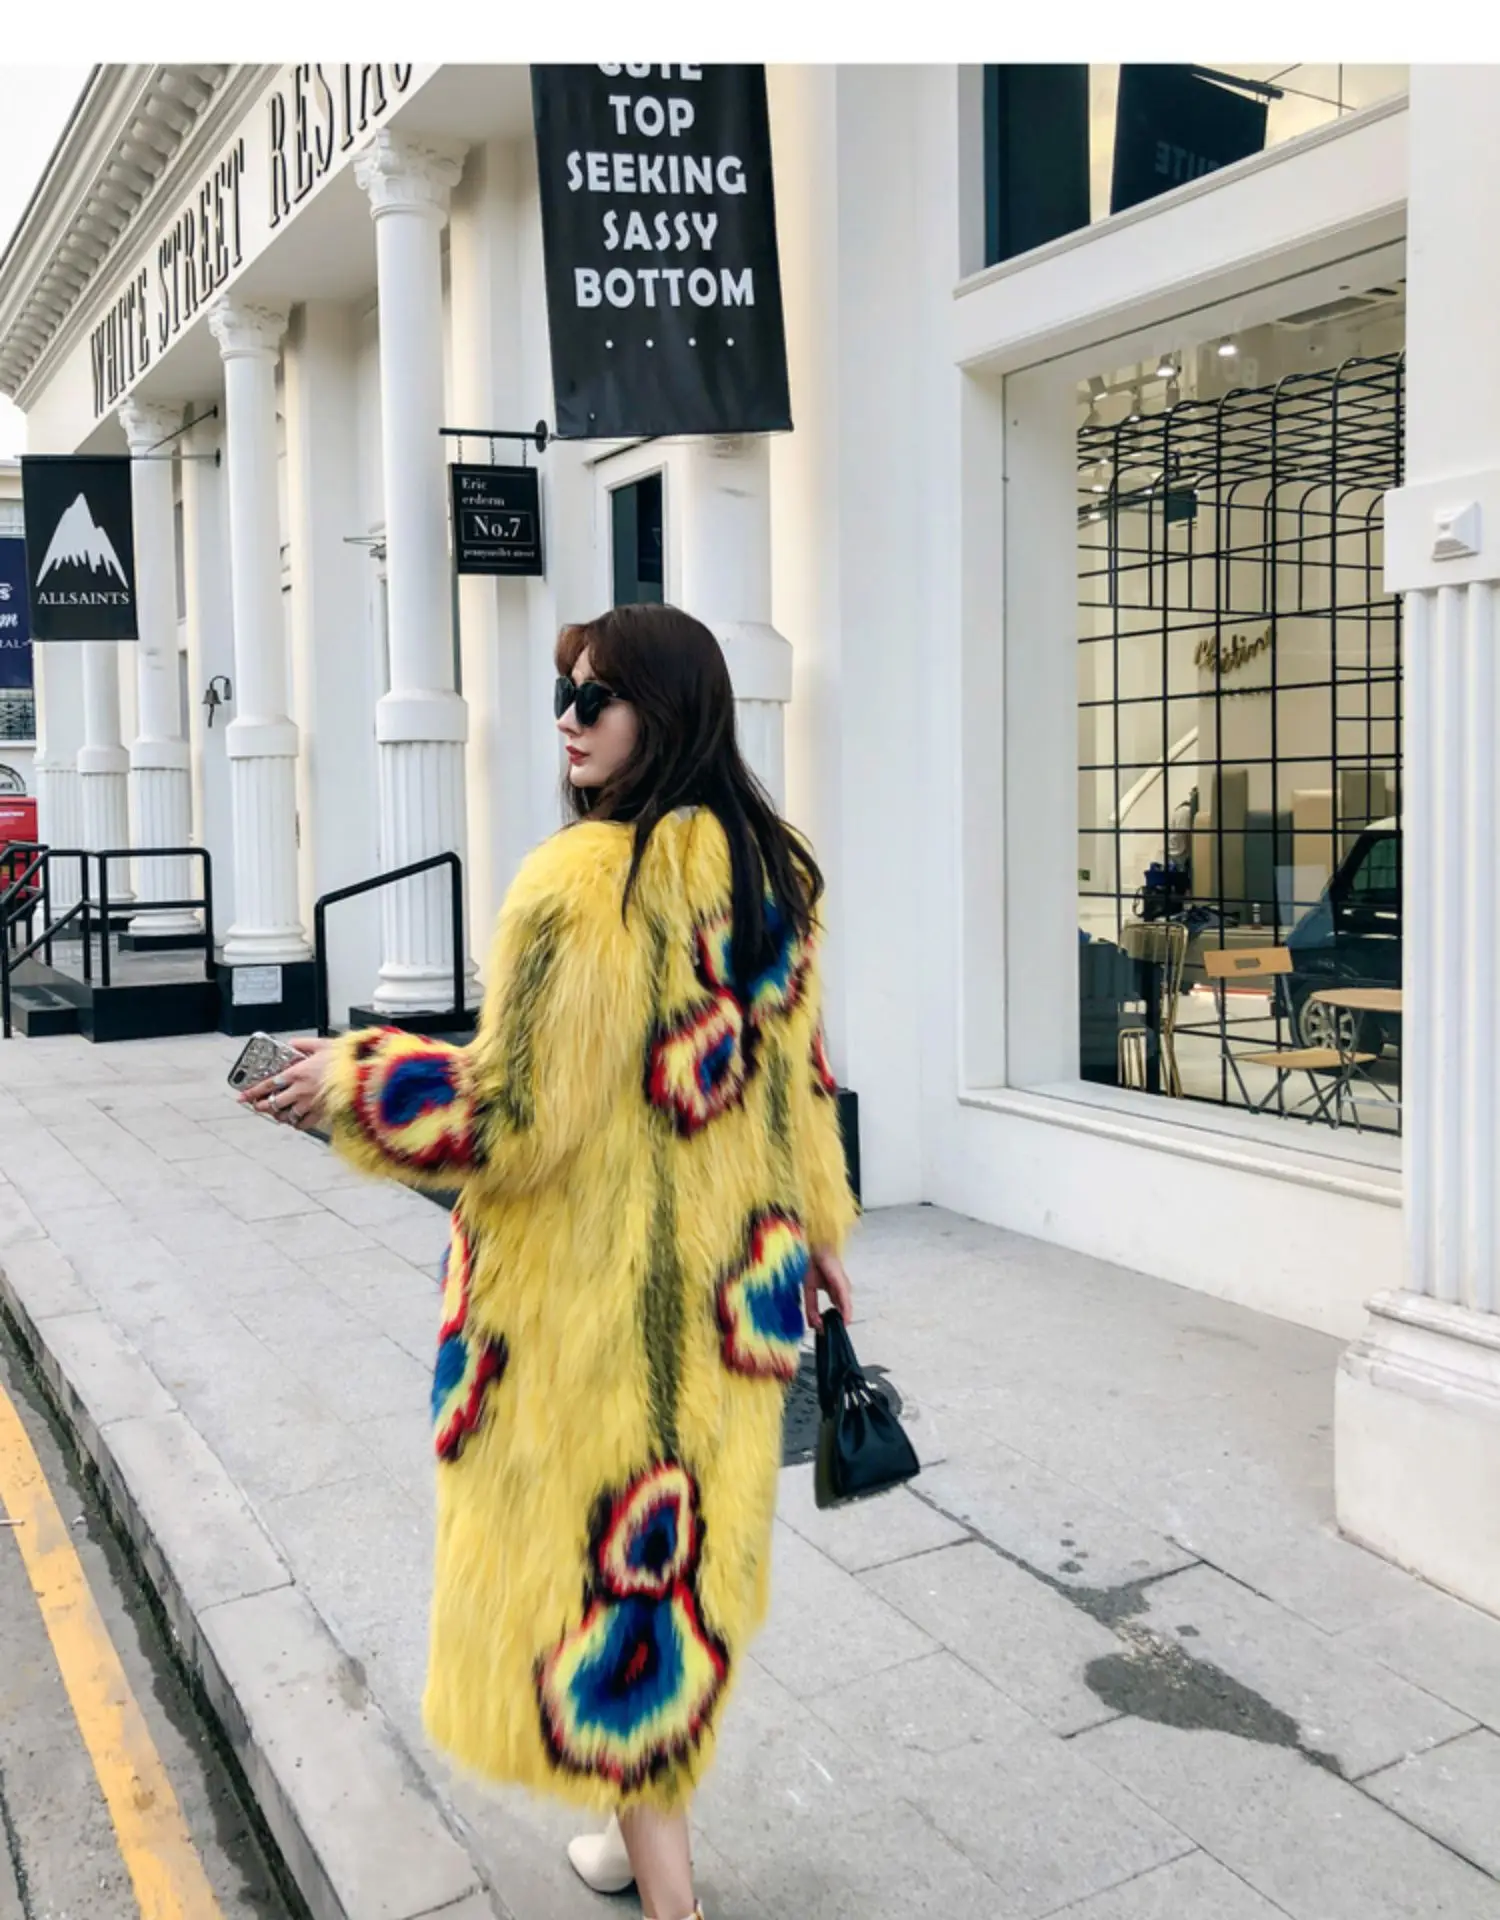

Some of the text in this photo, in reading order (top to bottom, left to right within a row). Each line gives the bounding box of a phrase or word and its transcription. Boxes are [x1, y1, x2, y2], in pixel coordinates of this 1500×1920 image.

[608, 95, 695, 137] TOP
[566, 150, 748, 195] SEEKING
[602, 209, 718, 251] SASSY
[90, 267, 150, 418] WHITE
[157, 137, 245, 353] STREET
[573, 267, 755, 308] BOTTOM
[473, 515, 521, 538] No.7
[37, 591, 130, 605] ALLSAINTS
